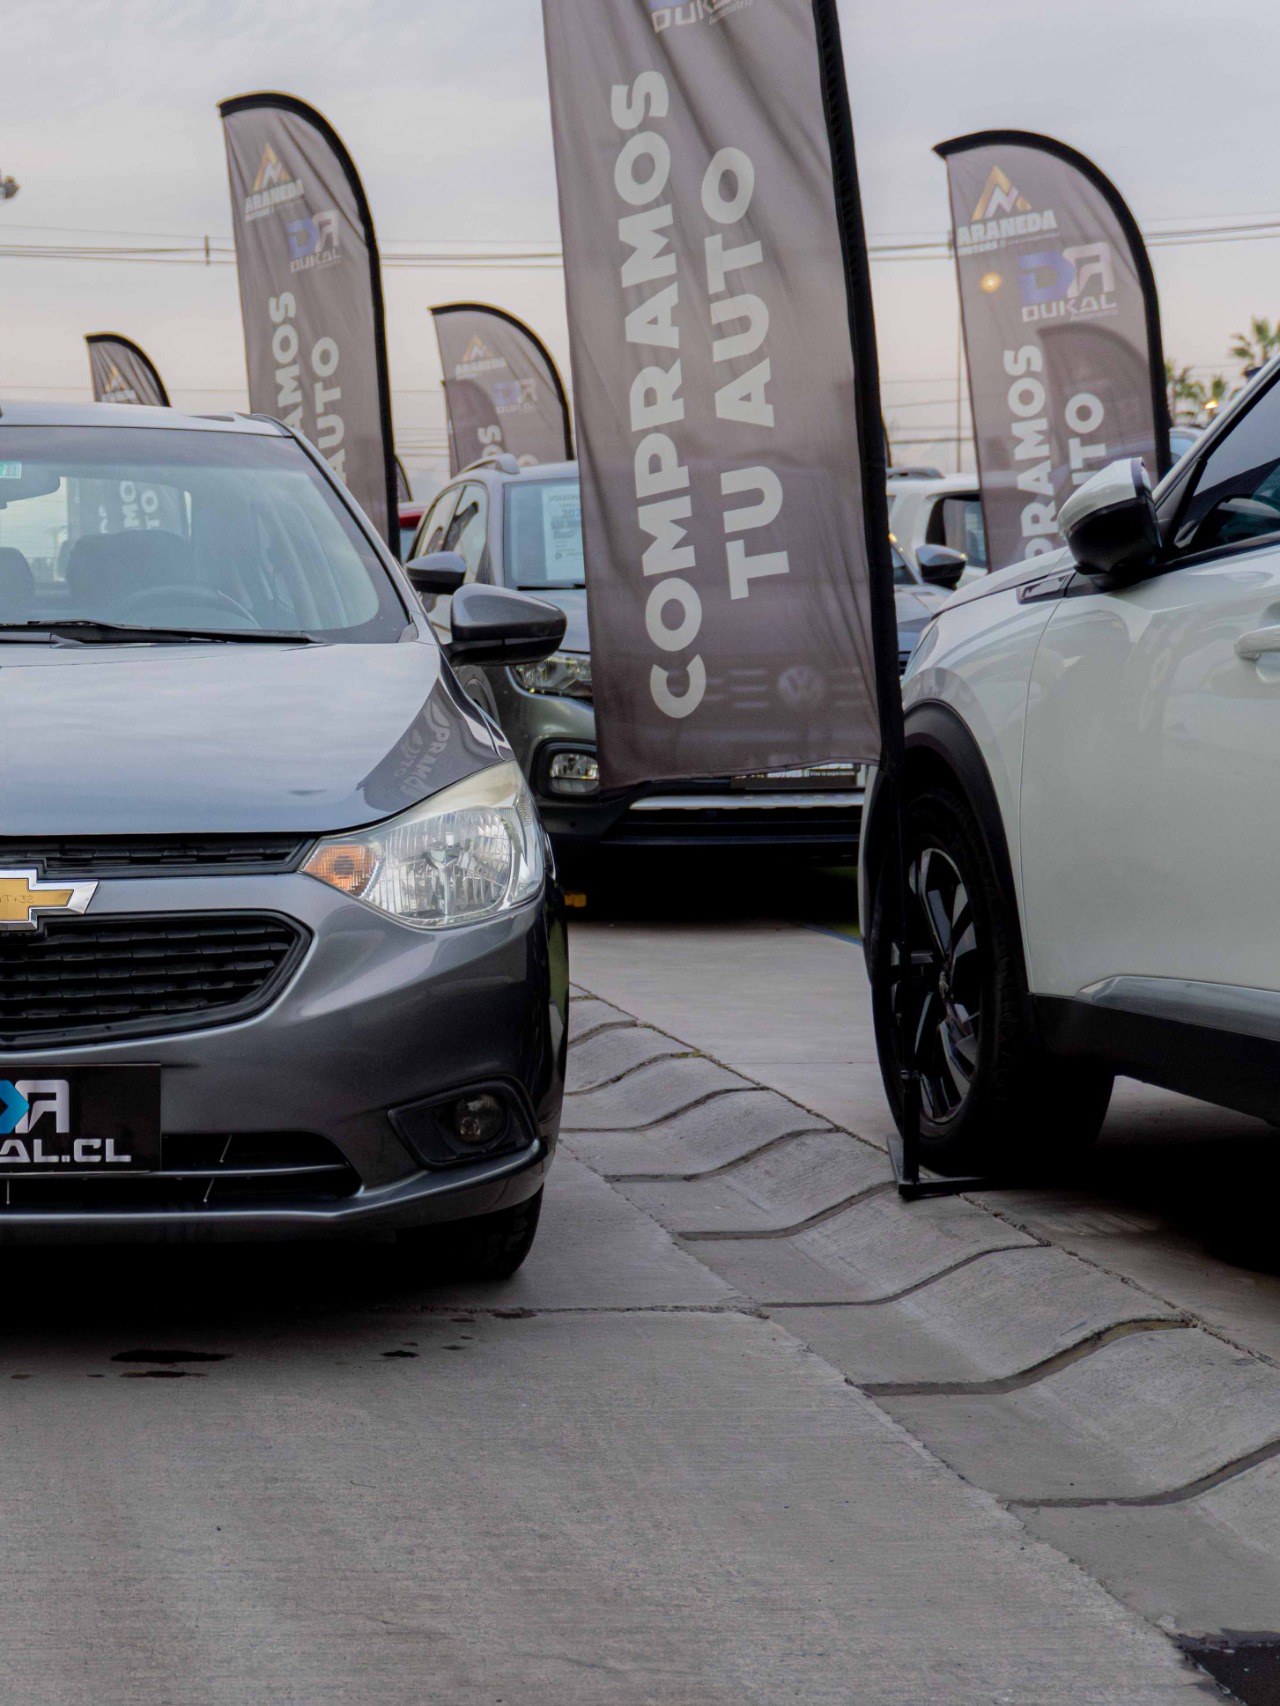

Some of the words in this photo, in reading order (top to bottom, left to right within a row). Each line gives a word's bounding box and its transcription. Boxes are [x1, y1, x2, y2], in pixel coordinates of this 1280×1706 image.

[700, 146, 776, 428] AUTO
[958, 209, 1058, 247] ARANEDA
[1022, 294, 1117, 322] DUKAL
[611, 70, 707, 719] COMPRAMOS
[721, 465, 790, 600] TU
